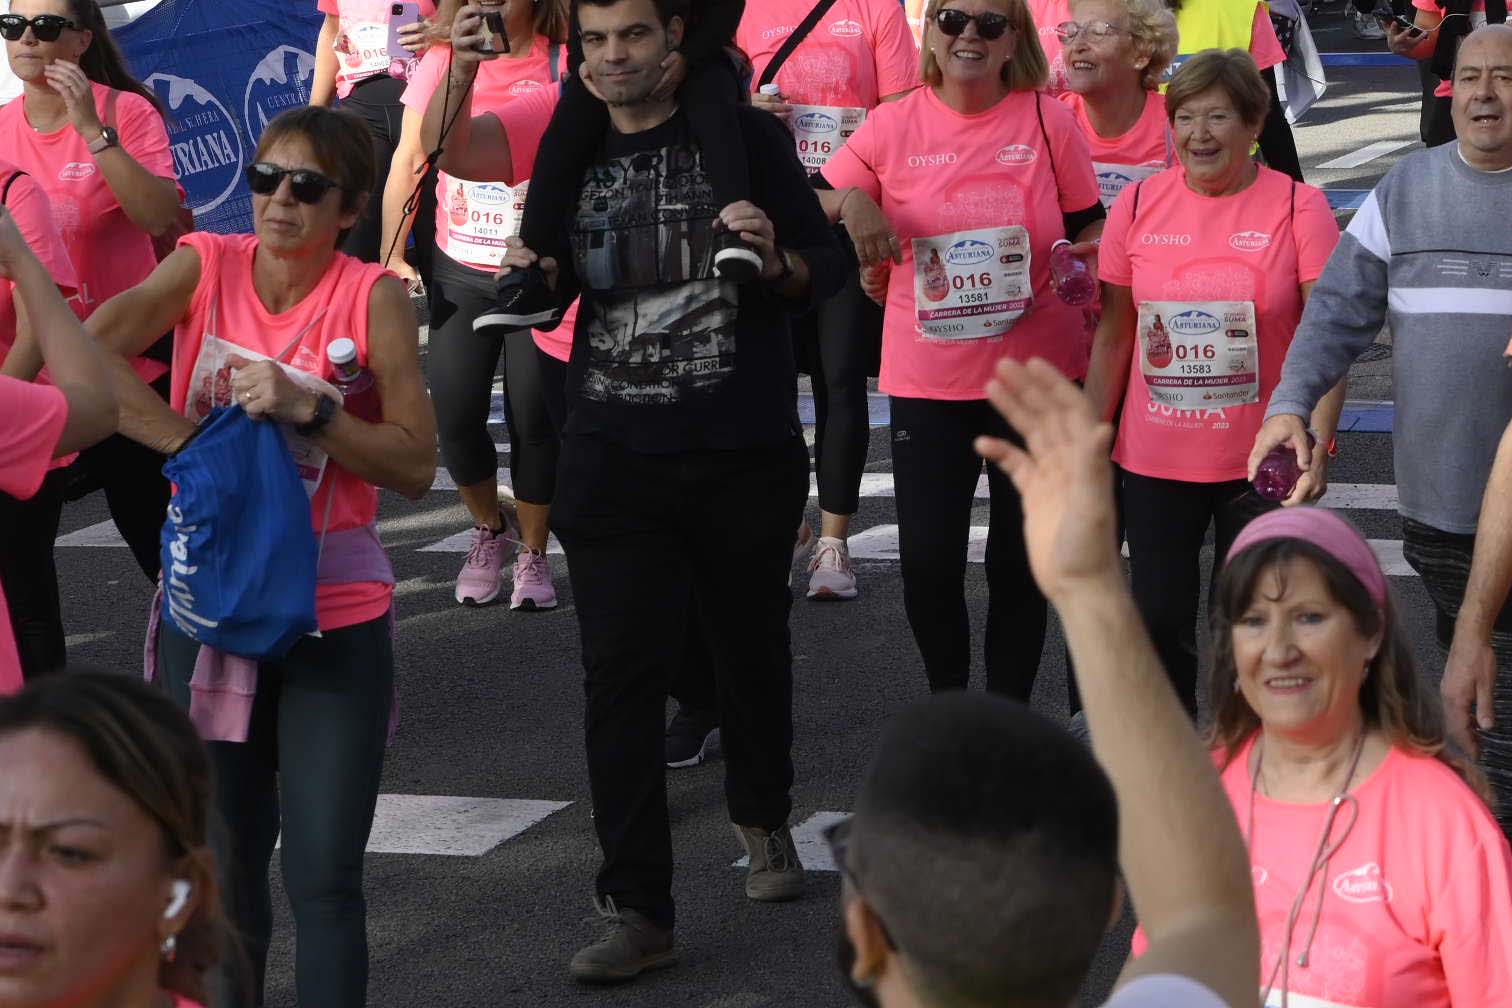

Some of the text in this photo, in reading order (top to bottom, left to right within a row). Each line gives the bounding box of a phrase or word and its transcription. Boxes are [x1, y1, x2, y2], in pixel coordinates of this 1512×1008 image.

[799, 140, 832, 154] 016
[908, 153, 957, 168] OYSHO
[471, 210, 504, 225] 016
[1142, 233, 1191, 246] OYSHO
[947, 249, 991, 260] ASTURIANA
[952, 272, 993, 290] 016
[958, 292, 989, 304] 13581
[1173, 319, 1217, 330] ASTURIANA
[1175, 344, 1216, 360] 016
[1180, 364, 1212, 374] 13583
